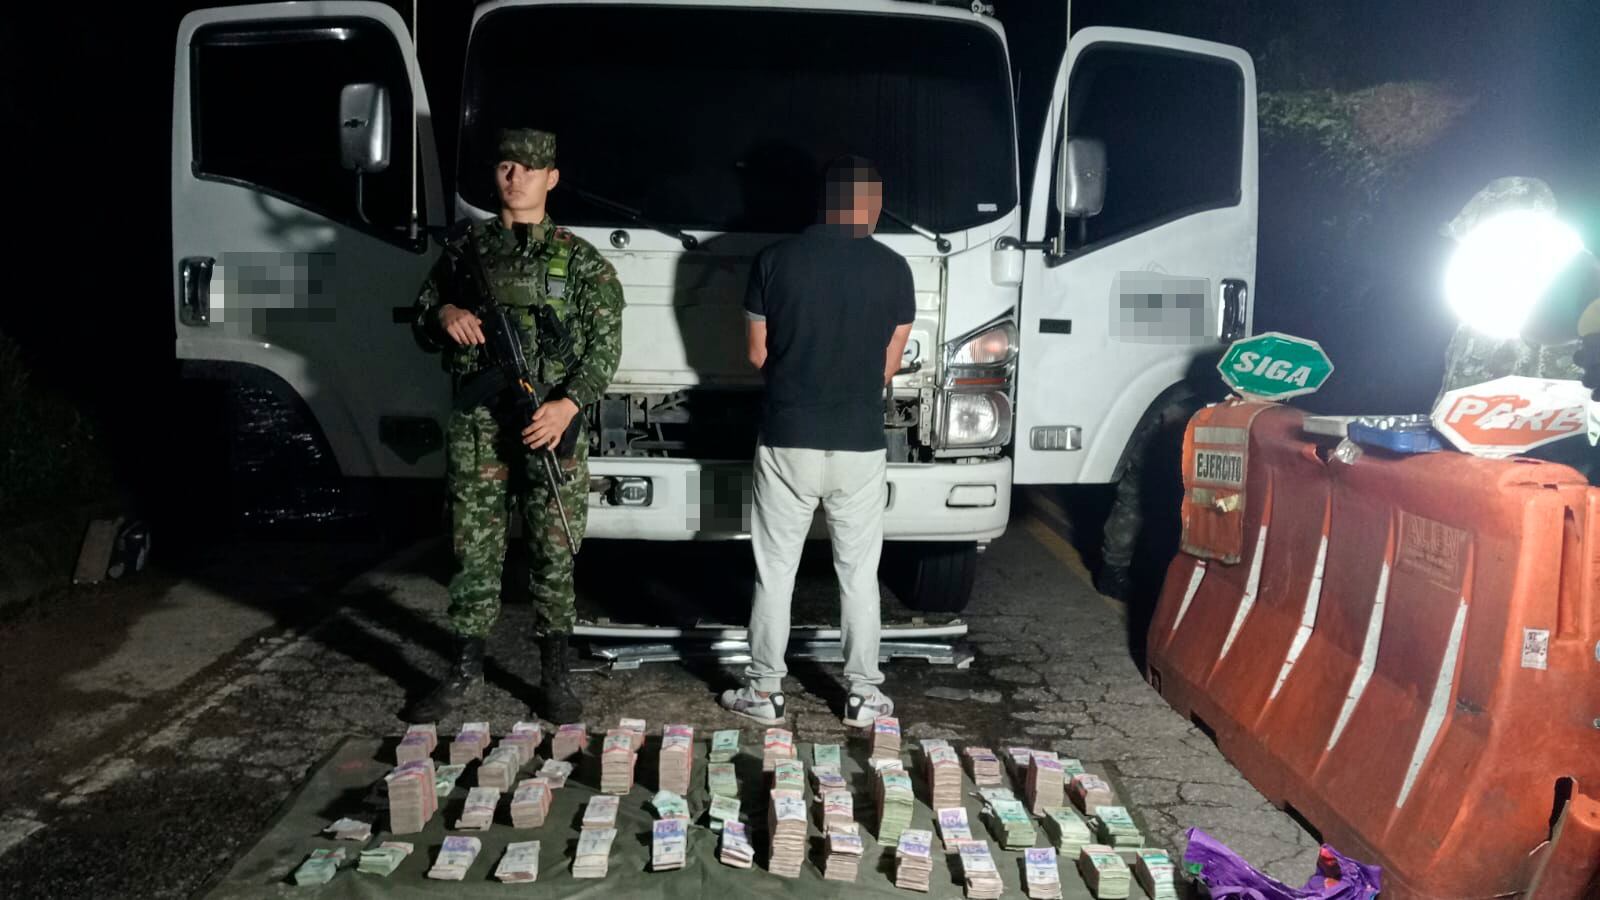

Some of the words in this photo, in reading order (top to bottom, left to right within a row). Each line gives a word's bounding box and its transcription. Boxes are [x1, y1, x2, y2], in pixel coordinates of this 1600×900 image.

[1233, 351, 1312, 387] SIGA
[1448, 397, 1585, 431] PARE
[1197, 452, 1242, 482] EJERCITO
